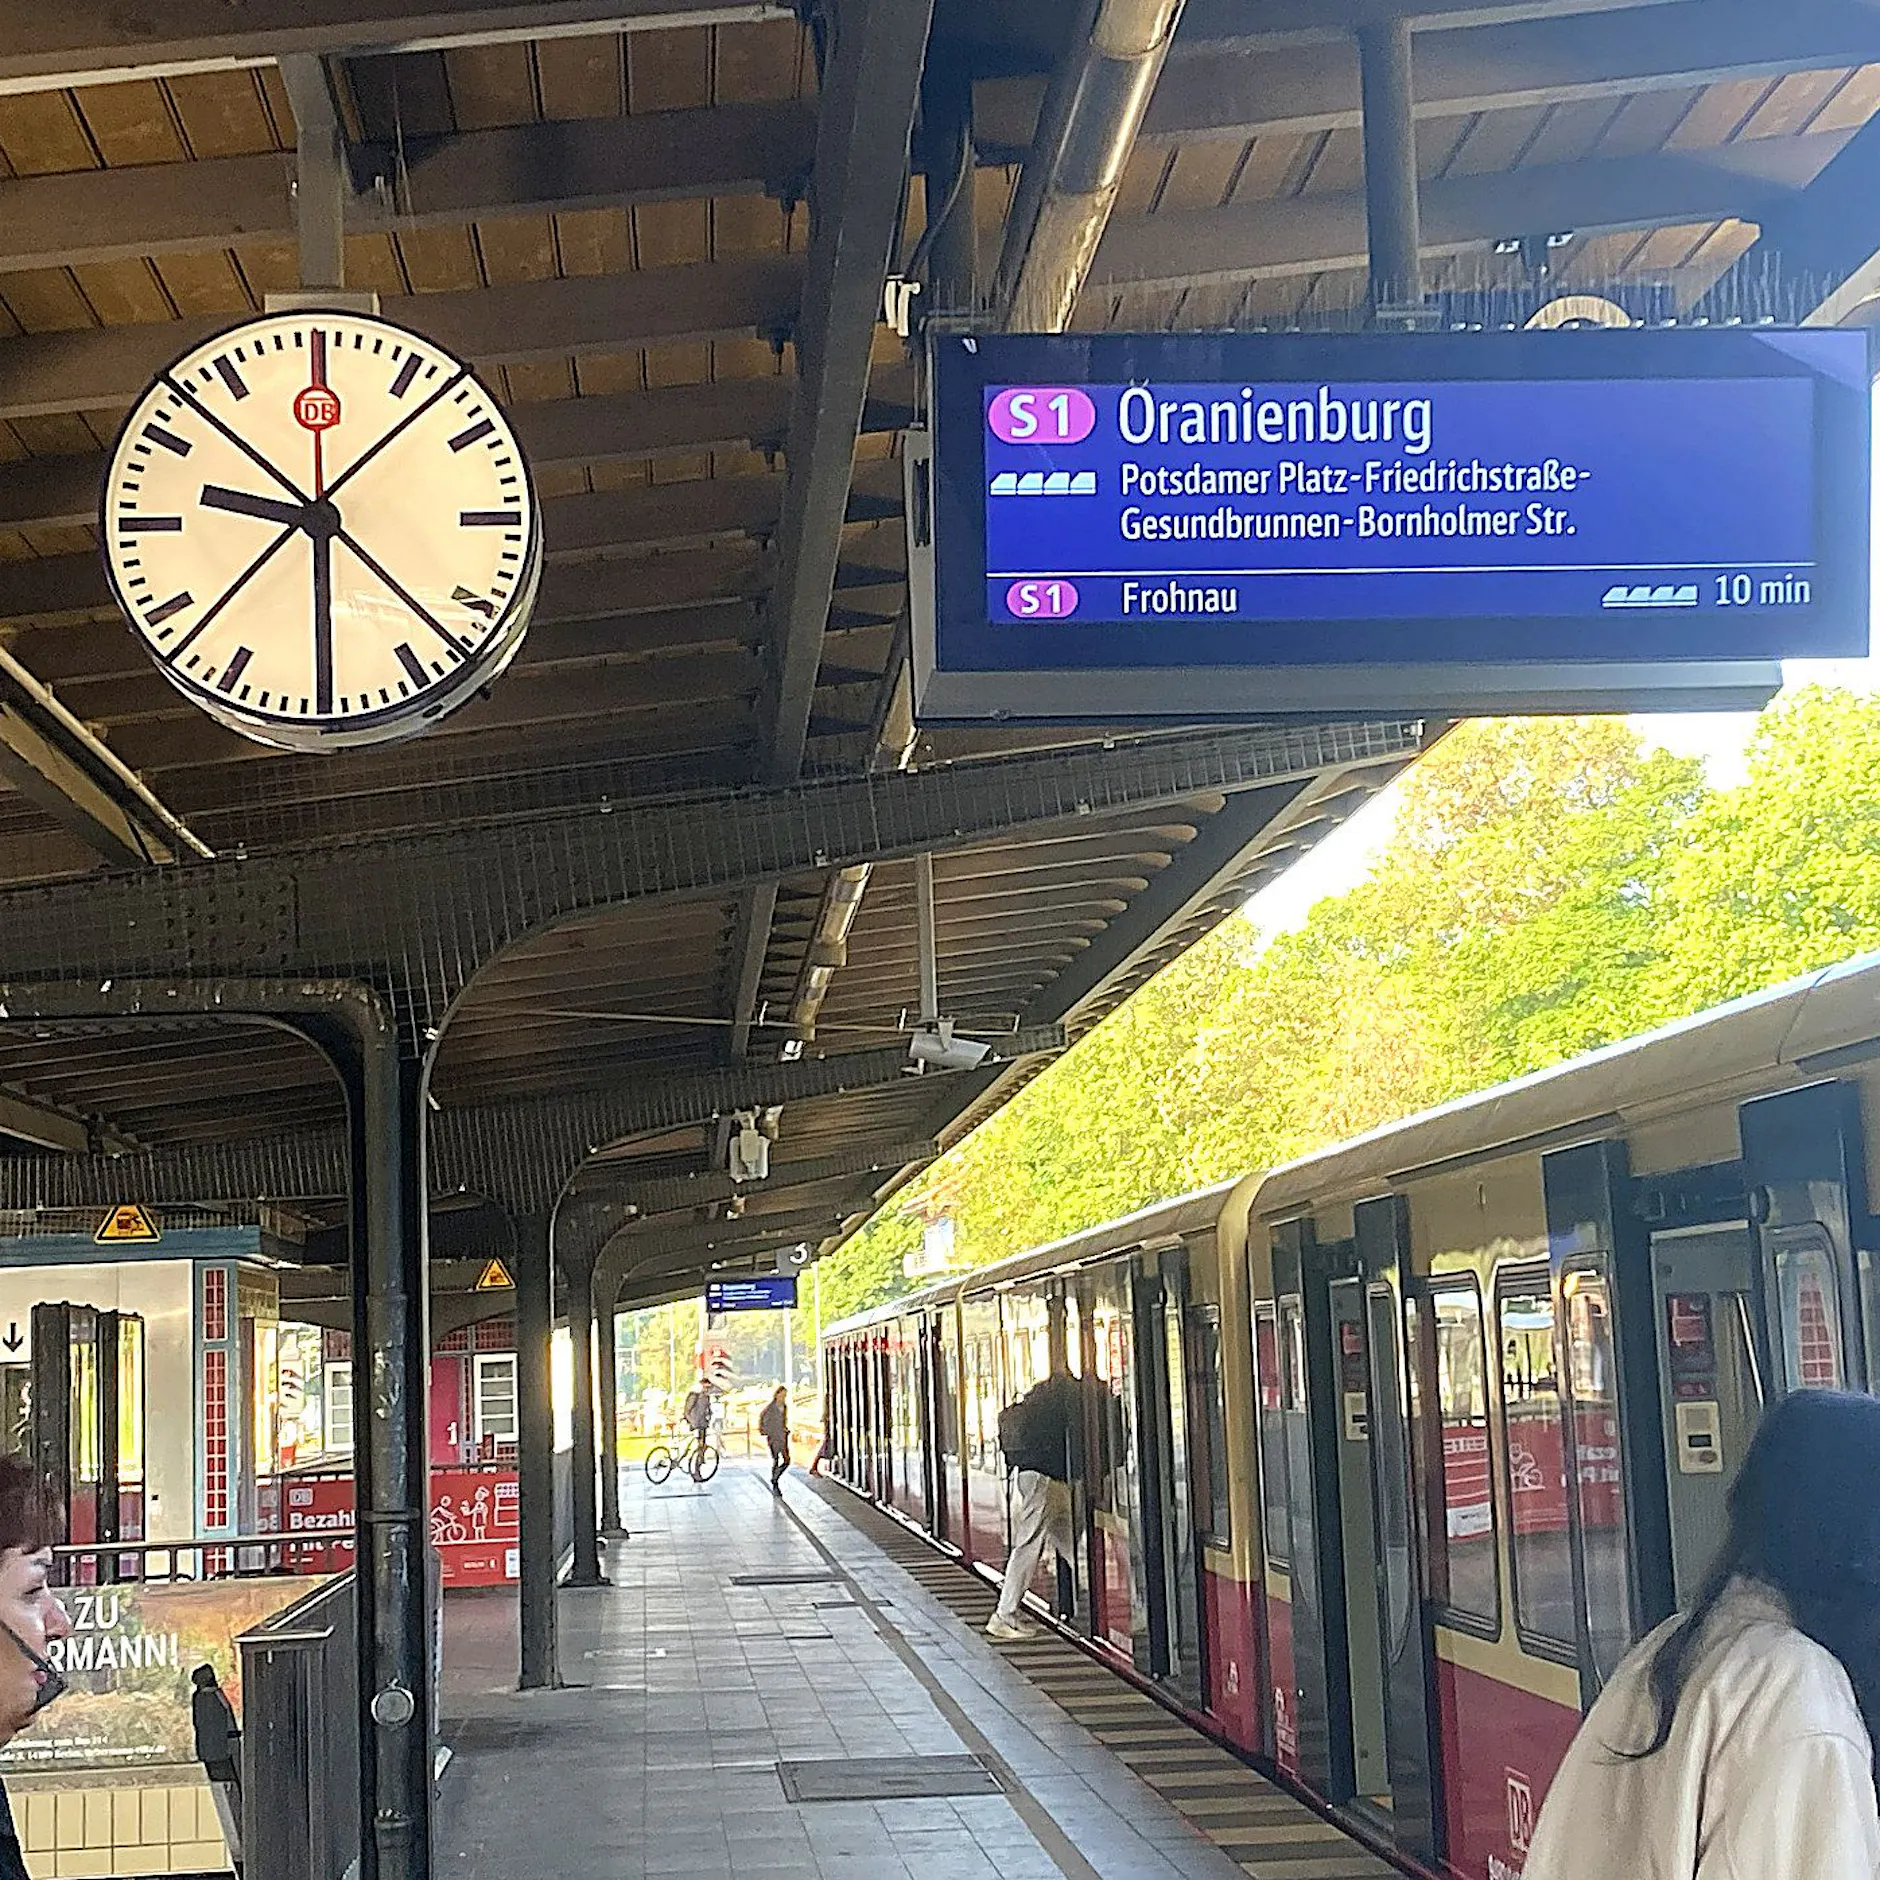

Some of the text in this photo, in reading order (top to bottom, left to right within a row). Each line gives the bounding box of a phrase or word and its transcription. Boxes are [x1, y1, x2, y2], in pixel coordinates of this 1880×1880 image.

[304, 403, 334, 421] DB
[1119, 386, 1432, 455] Oranienburg
[1122, 462, 1272, 496] Potsdamer
[1526, 503, 1576, 536] Str.
[1123, 582, 1238, 614] Frohnau
[1715, 573, 1811, 606] 10 min
[74, 1595, 120, 1631] ZU
